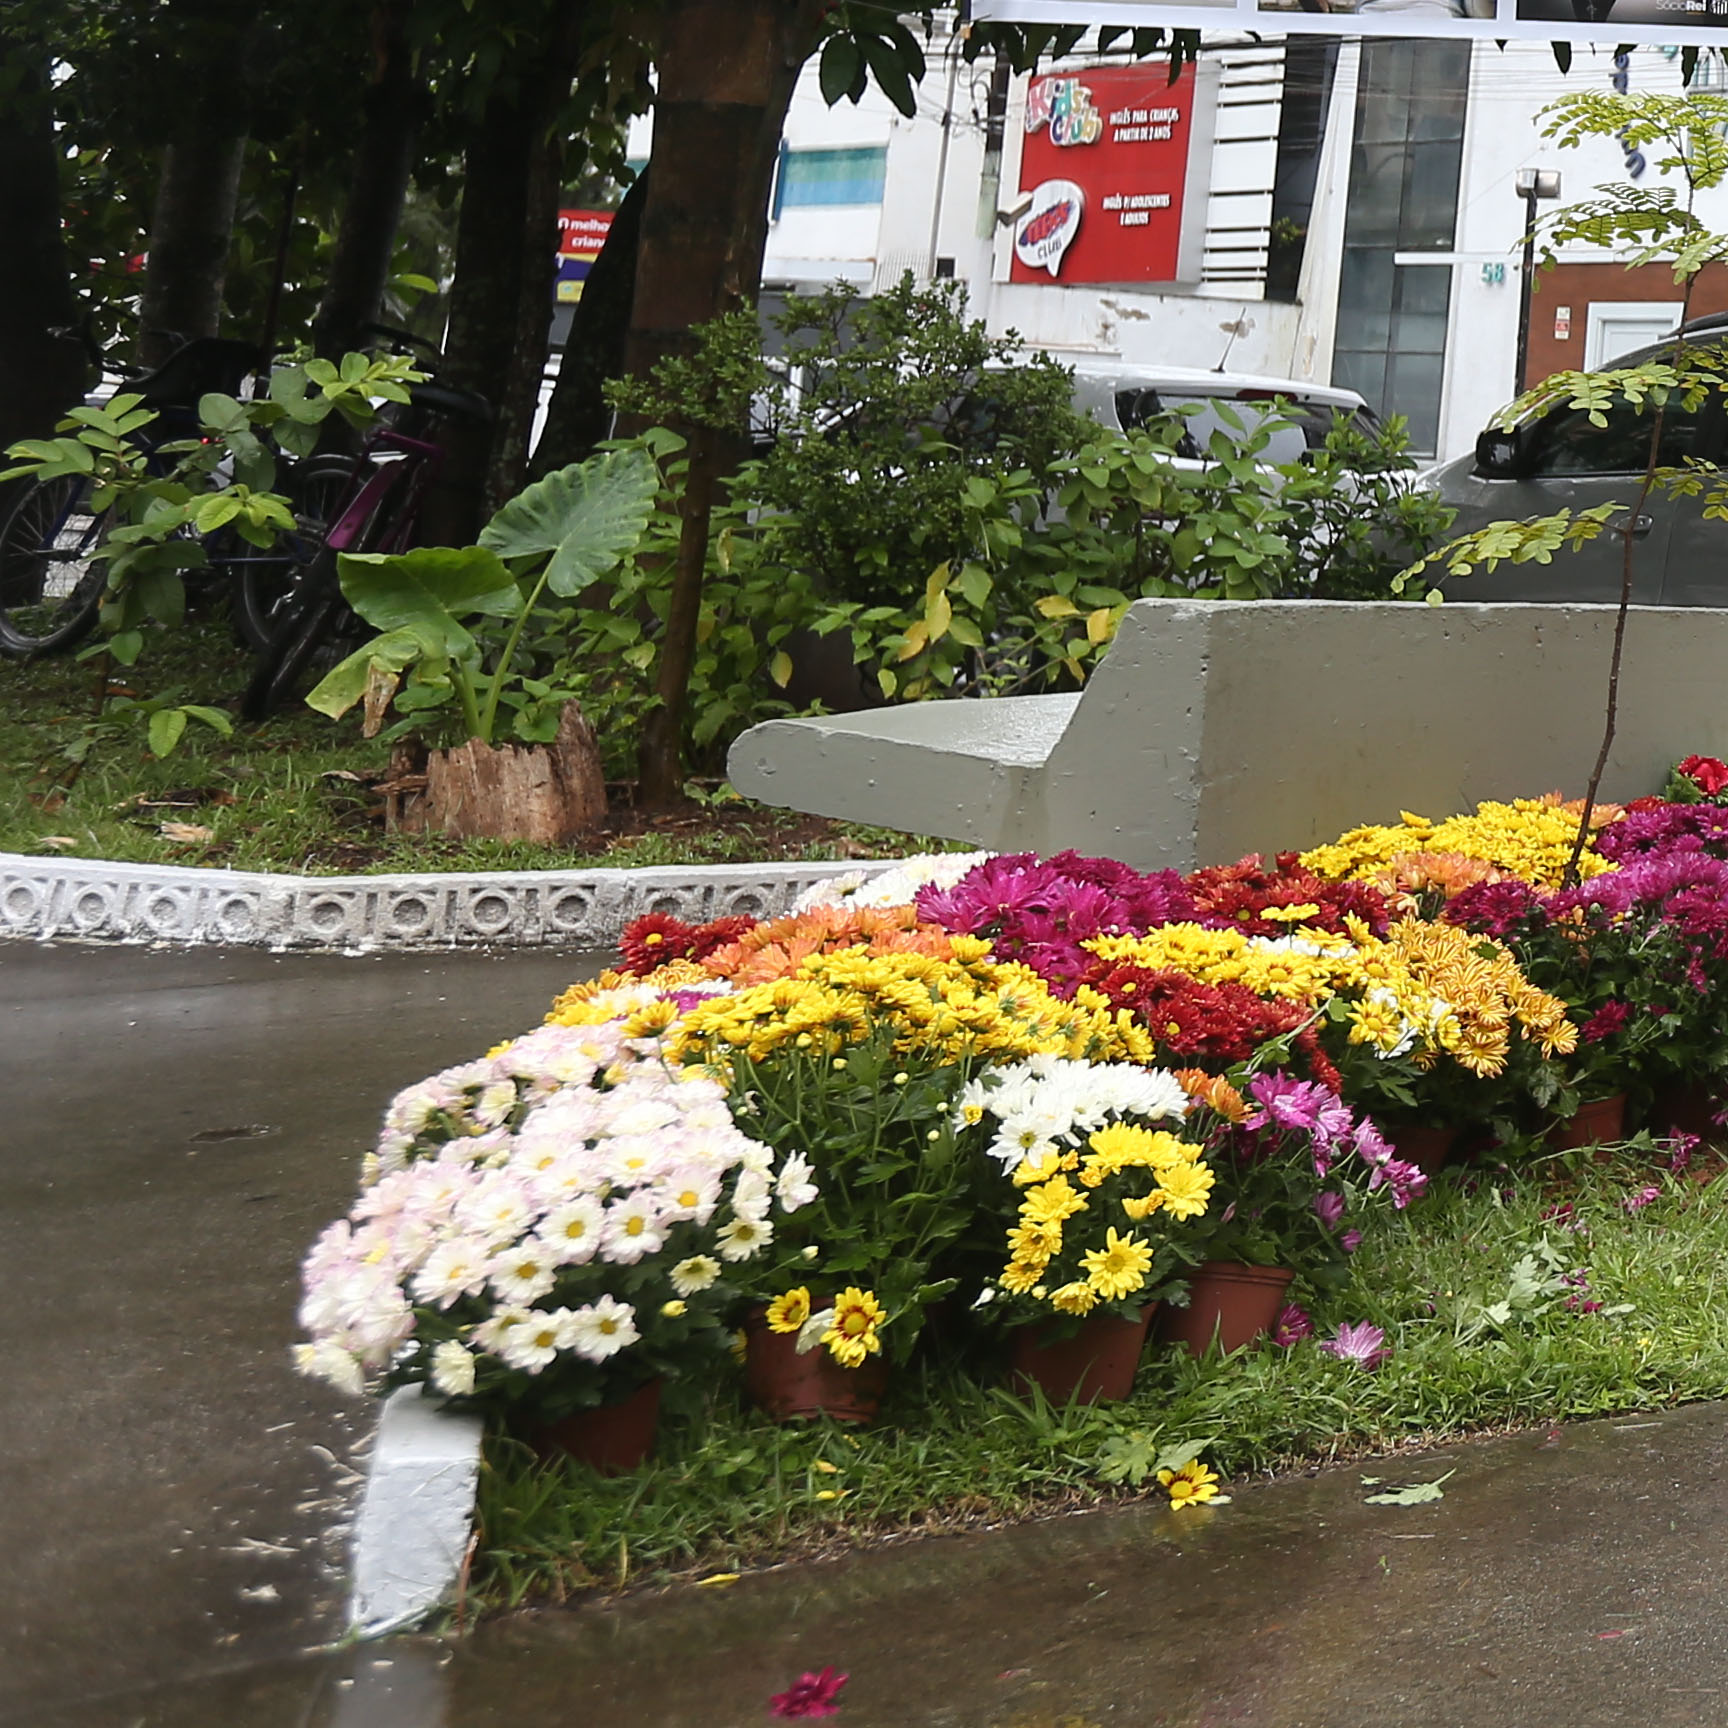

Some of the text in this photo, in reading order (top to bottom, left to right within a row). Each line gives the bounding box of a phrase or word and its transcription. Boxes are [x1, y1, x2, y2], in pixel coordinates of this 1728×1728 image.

[1028, 78, 1091, 119] Kids
[1109, 108, 1131, 125] INGLÊS
[1132, 110, 1147, 124] PARA
[570, 218, 611, 233] melho
[571, 235, 606, 248] crian
[1481, 263, 1505, 285] 58
